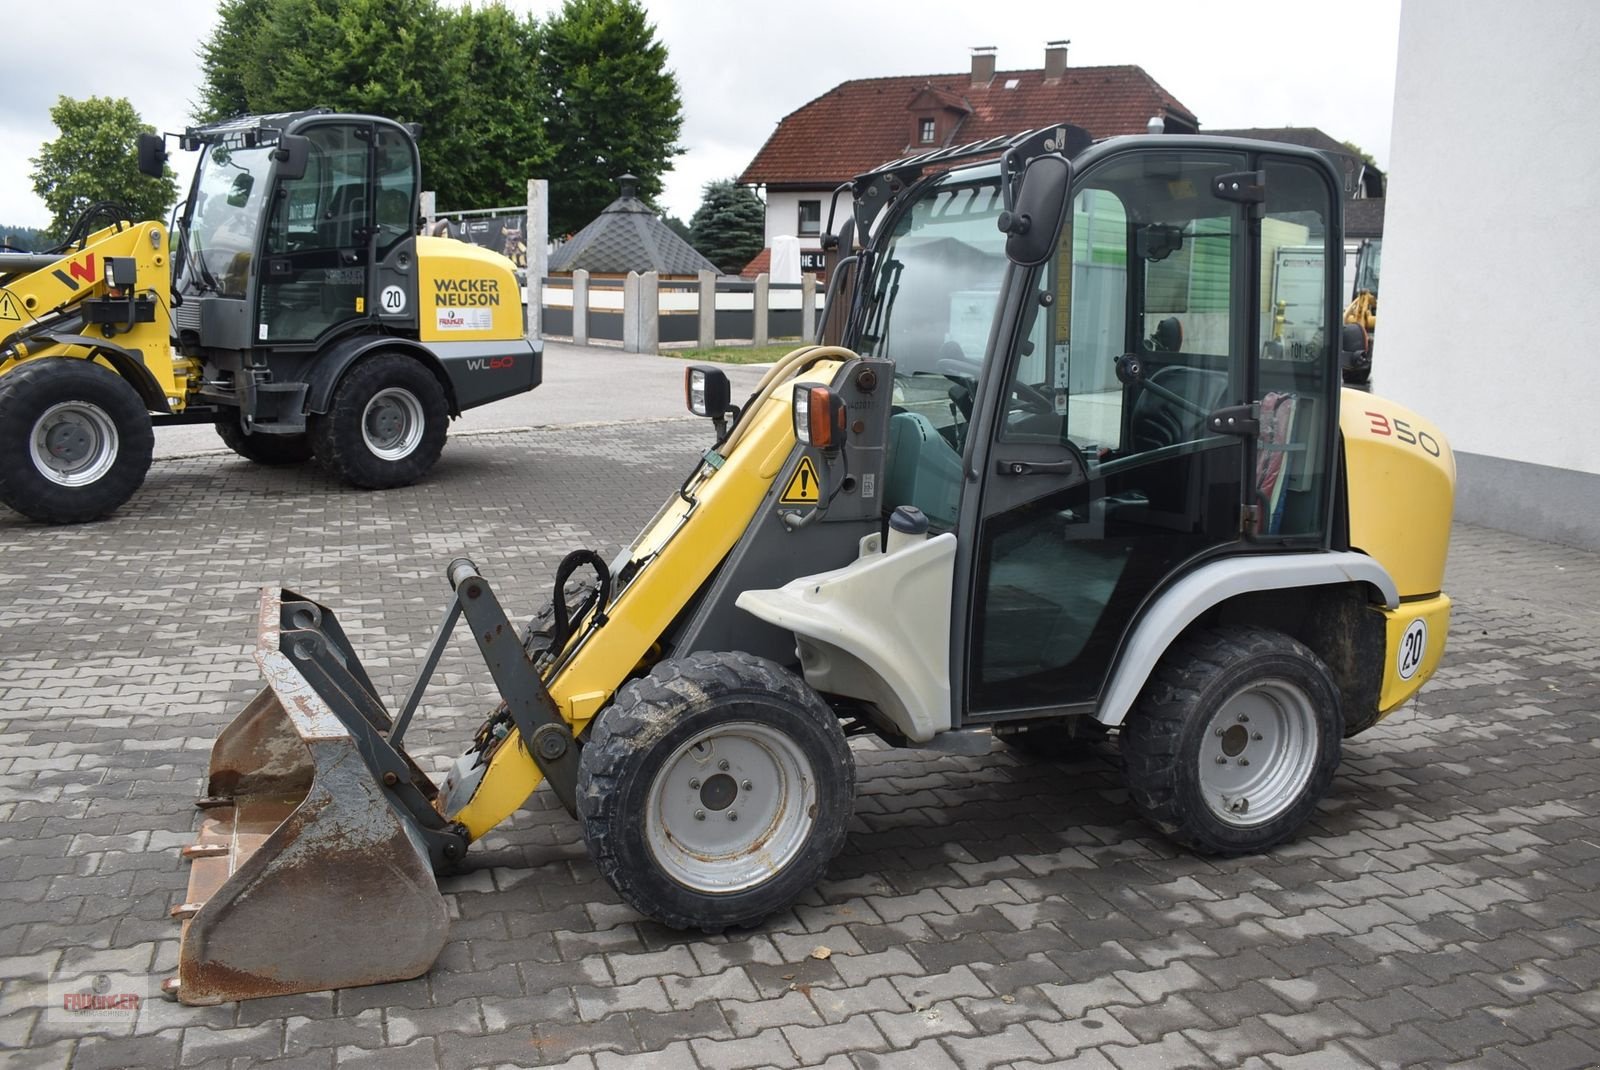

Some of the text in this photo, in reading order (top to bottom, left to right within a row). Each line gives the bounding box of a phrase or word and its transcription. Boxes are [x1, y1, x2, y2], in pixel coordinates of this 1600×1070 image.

[800, 255, 813, 267] HE
[433, 279, 499, 292] WACKER
[386, 290, 401, 308] 20
[435, 293, 500, 306] NEUSON
[466, 356, 514, 371] WL60
[1364, 411, 1441, 458] 350
[1402, 629, 1423, 671] 20
